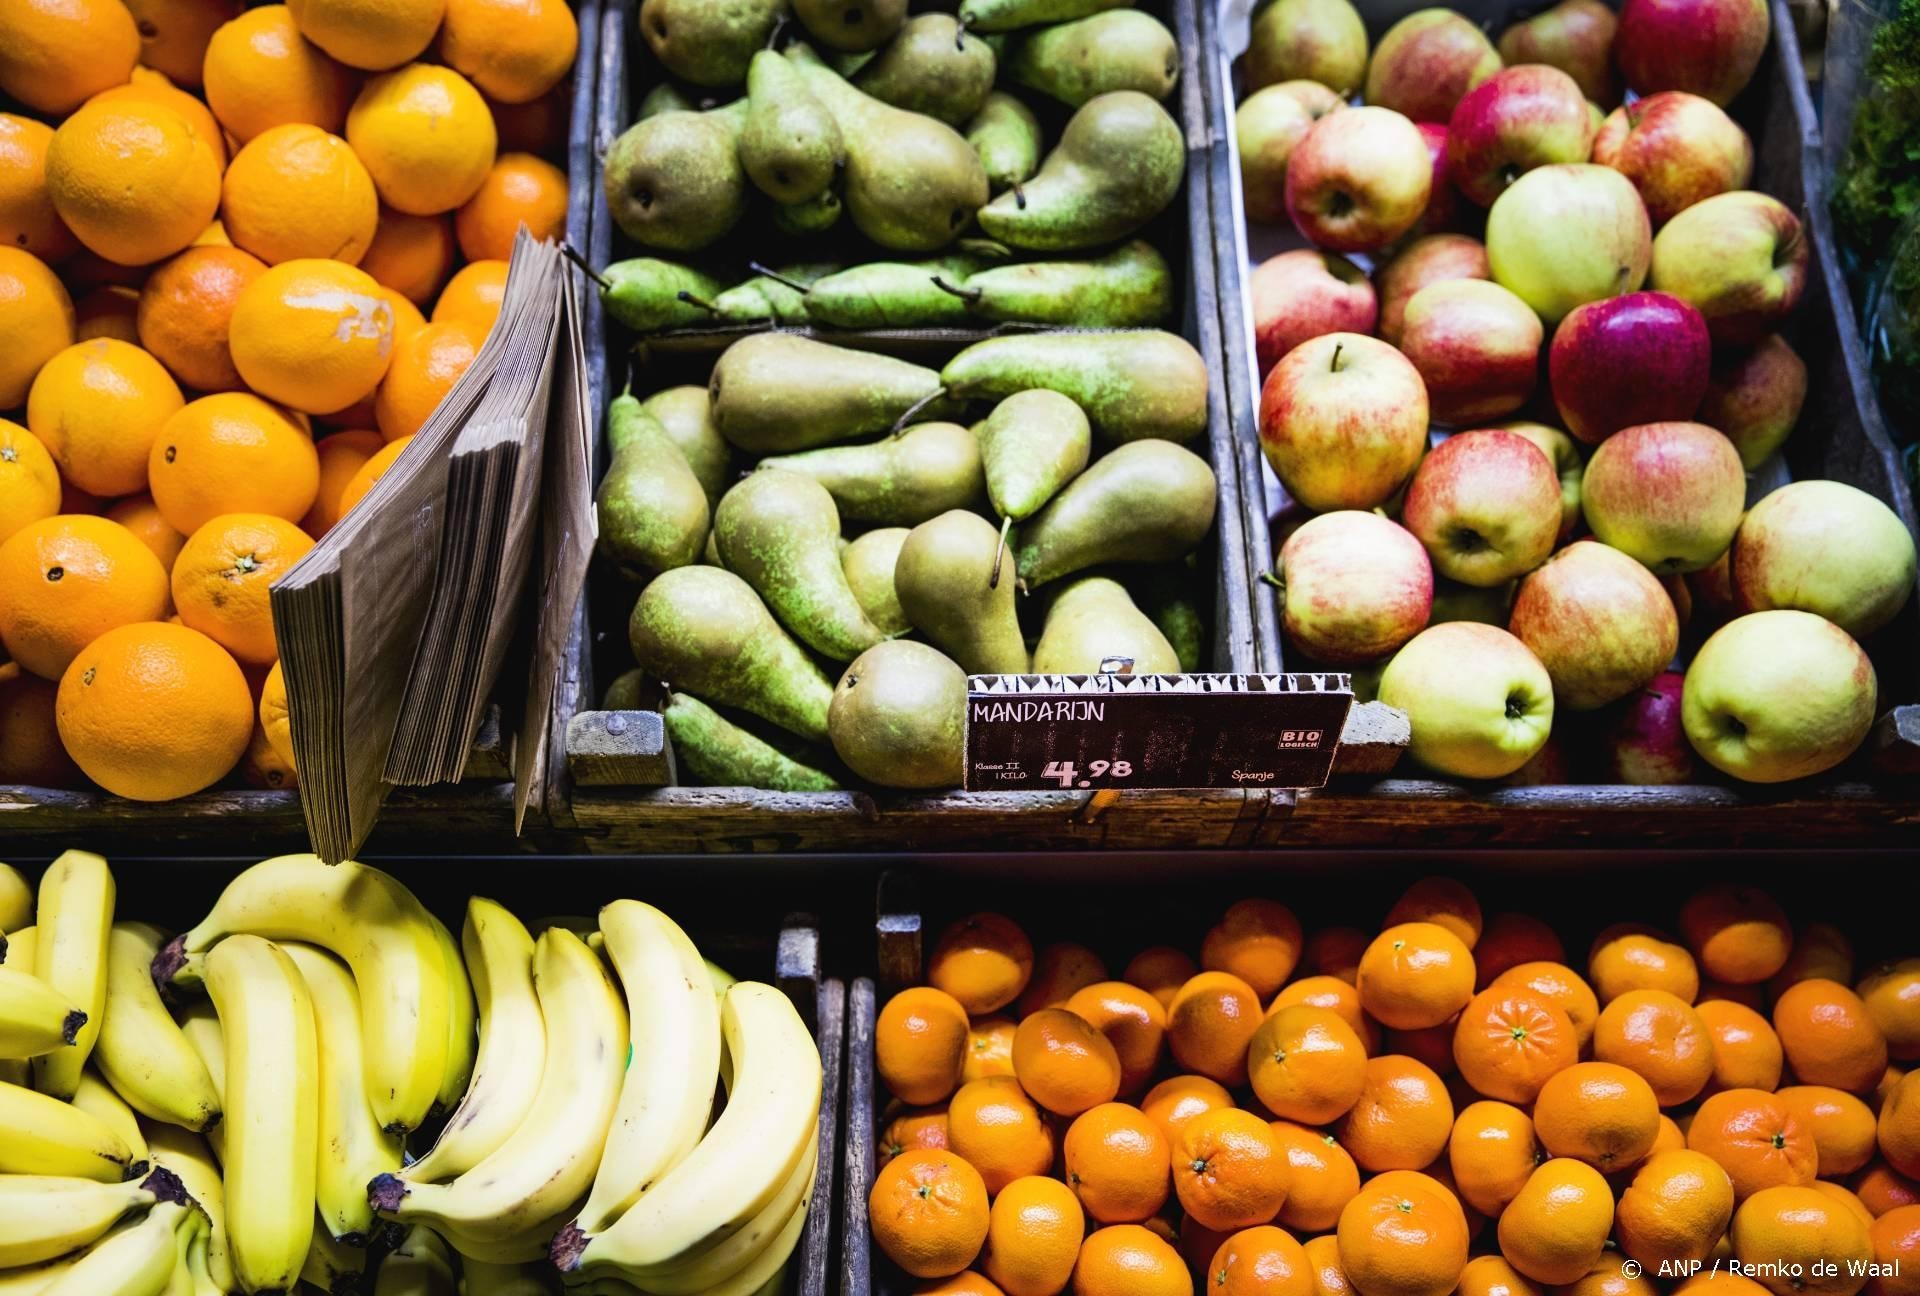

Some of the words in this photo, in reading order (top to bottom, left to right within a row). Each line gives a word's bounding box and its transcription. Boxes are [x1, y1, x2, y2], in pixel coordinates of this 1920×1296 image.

[974, 701, 1105, 722] MANDARIJN
[1282, 731, 1320, 742] BIO
[1041, 759, 1133, 788] 4.98
[1231, 769, 1275, 782] Spanje
